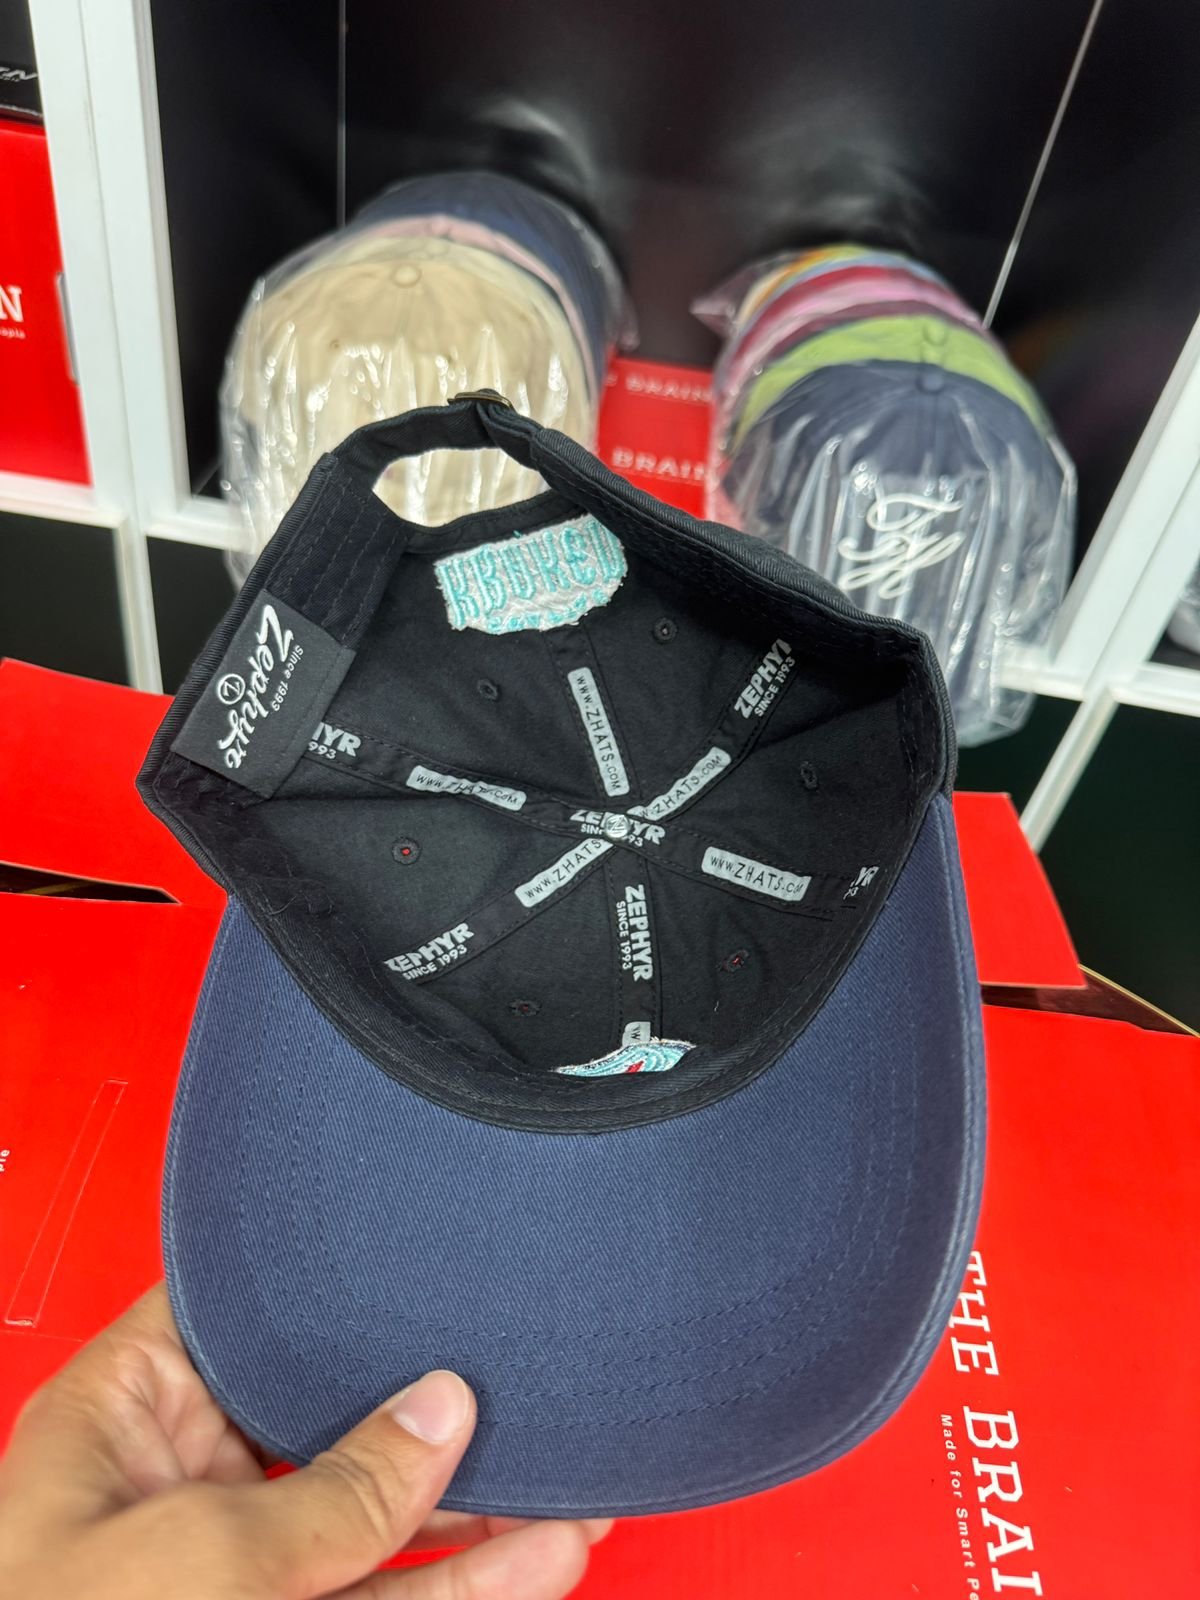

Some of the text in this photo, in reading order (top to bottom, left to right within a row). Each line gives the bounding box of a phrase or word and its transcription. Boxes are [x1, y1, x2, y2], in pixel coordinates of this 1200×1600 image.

[216, 604, 294, 769] Zephyr
[271, 645, 304, 712] Since 1993
[754, 656, 796, 717] SINCE 1993
[308, 741, 337, 759] 993
[402, 944, 468, 980] SINCE 1993
[616, 900, 633, 970] SINCE 1993
[624, 884, 653, 982] ZEPHYR
[949, 1250, 999, 1376] THE
[940, 1414, 957, 1461] Made
[950, 1470, 963, 1499] for
[956, 1507, 976, 1569] Smart
